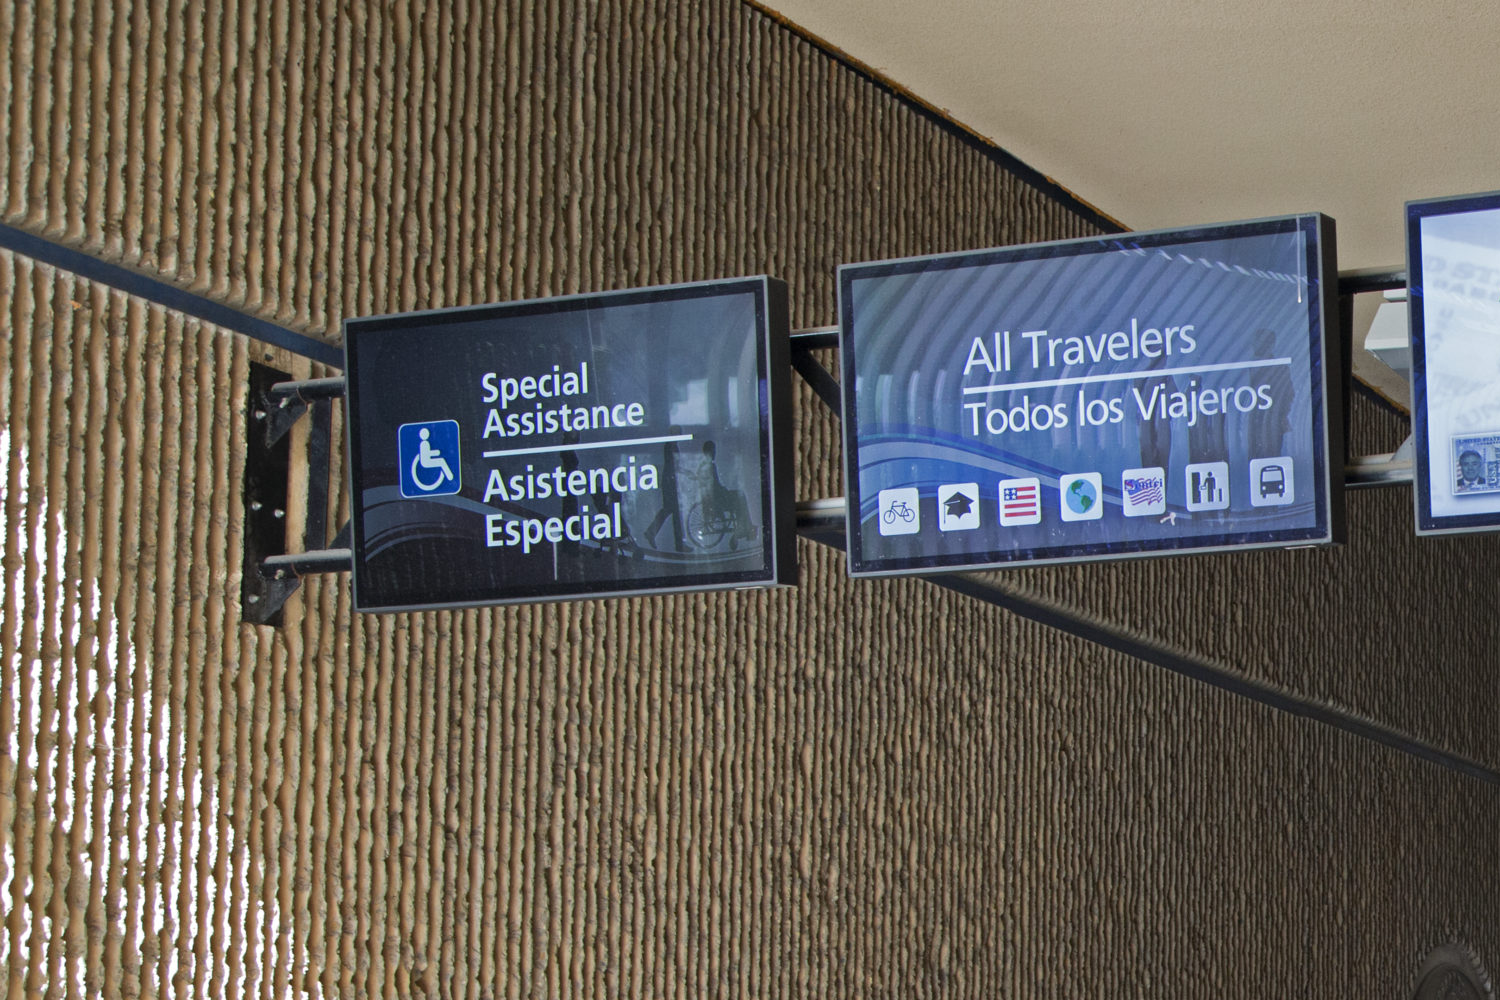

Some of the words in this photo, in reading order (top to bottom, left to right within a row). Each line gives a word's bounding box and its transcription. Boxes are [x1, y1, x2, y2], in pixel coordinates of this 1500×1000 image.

[963, 332, 1010, 375] All
[1022, 318, 1197, 369] Travelers
[482, 361, 589, 409] Special
[964, 396, 1068, 436] Todos
[1078, 390, 1124, 427] los
[1133, 382, 1273, 427] Viajeros
[483, 400, 645, 439] Assistance
[483, 456, 659, 503] Asistencia
[485, 503, 622, 554] Especial
